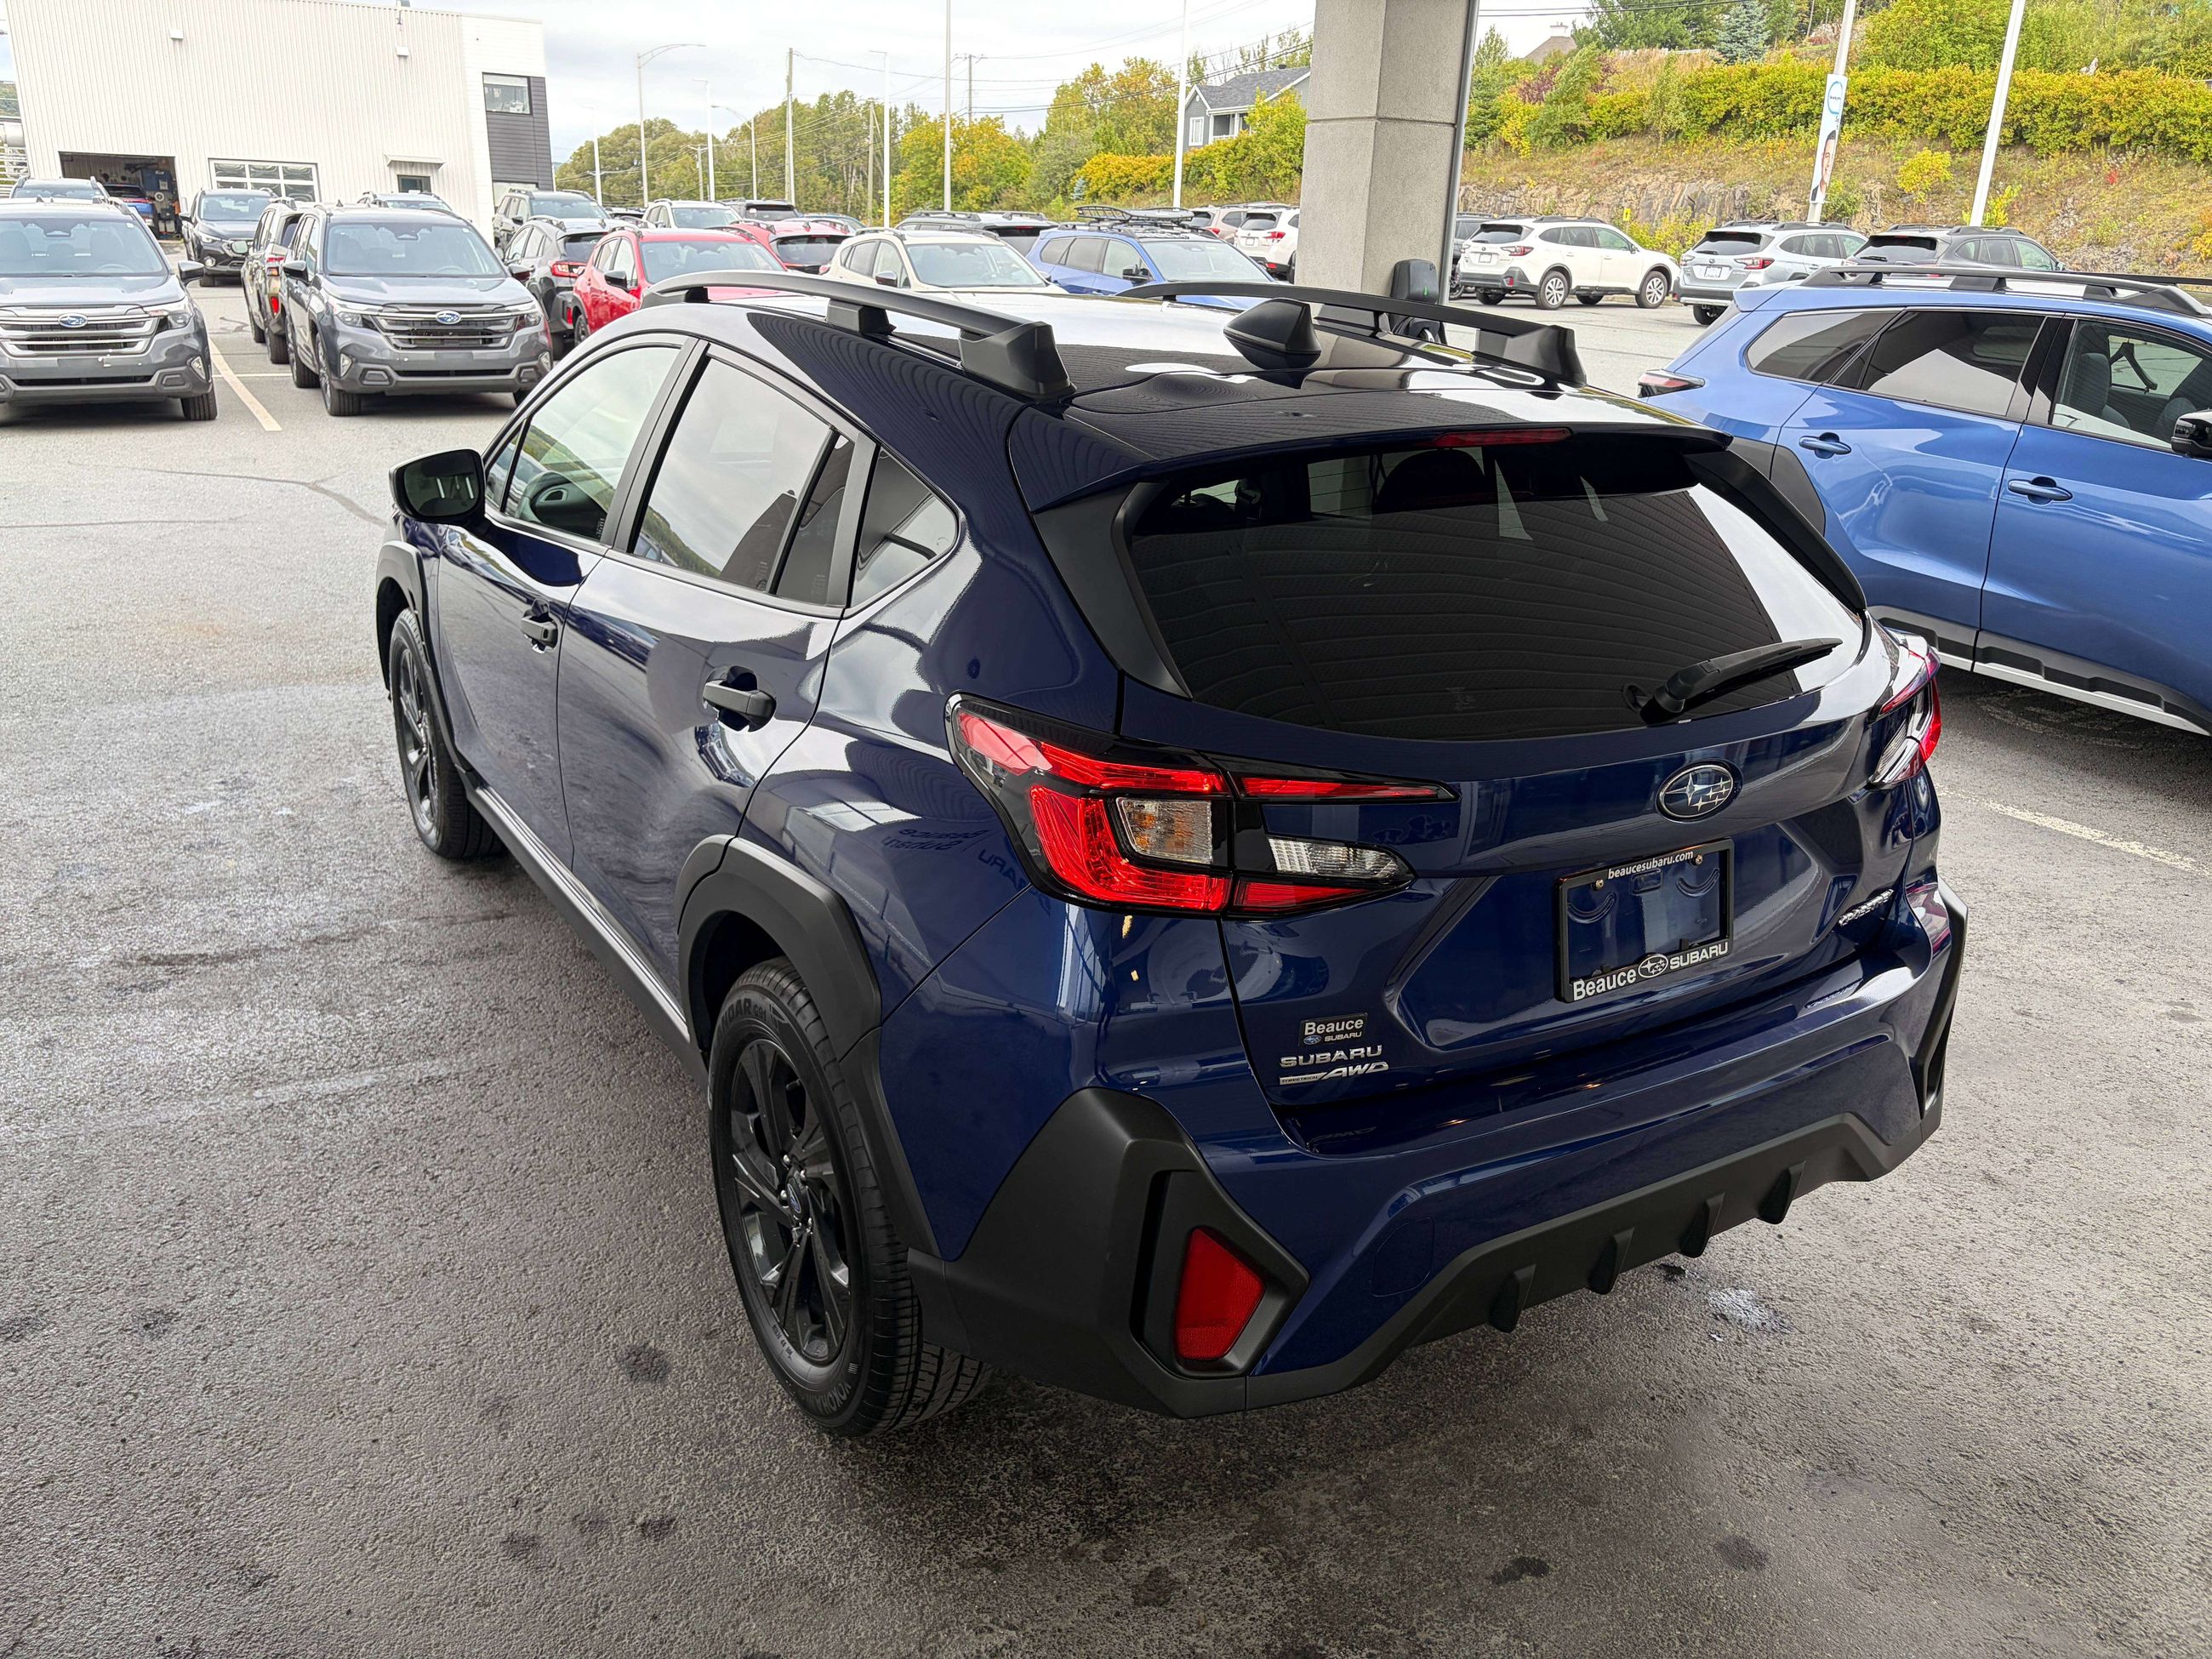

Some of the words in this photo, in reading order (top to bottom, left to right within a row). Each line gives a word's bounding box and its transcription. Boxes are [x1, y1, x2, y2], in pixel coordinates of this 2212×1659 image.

[1608, 851, 1694, 879] beaucesubaru.com
[1573, 967, 1636, 1001] Beauce
[1669, 942, 1729, 970] SUBARU
[1305, 1018, 1363, 1035] Beauce
[1325, 1032, 1361, 1041] SUBARU
[1280, 1045, 1382, 1068] SUBARU
[1320, 1062, 1388, 1080] AWD
